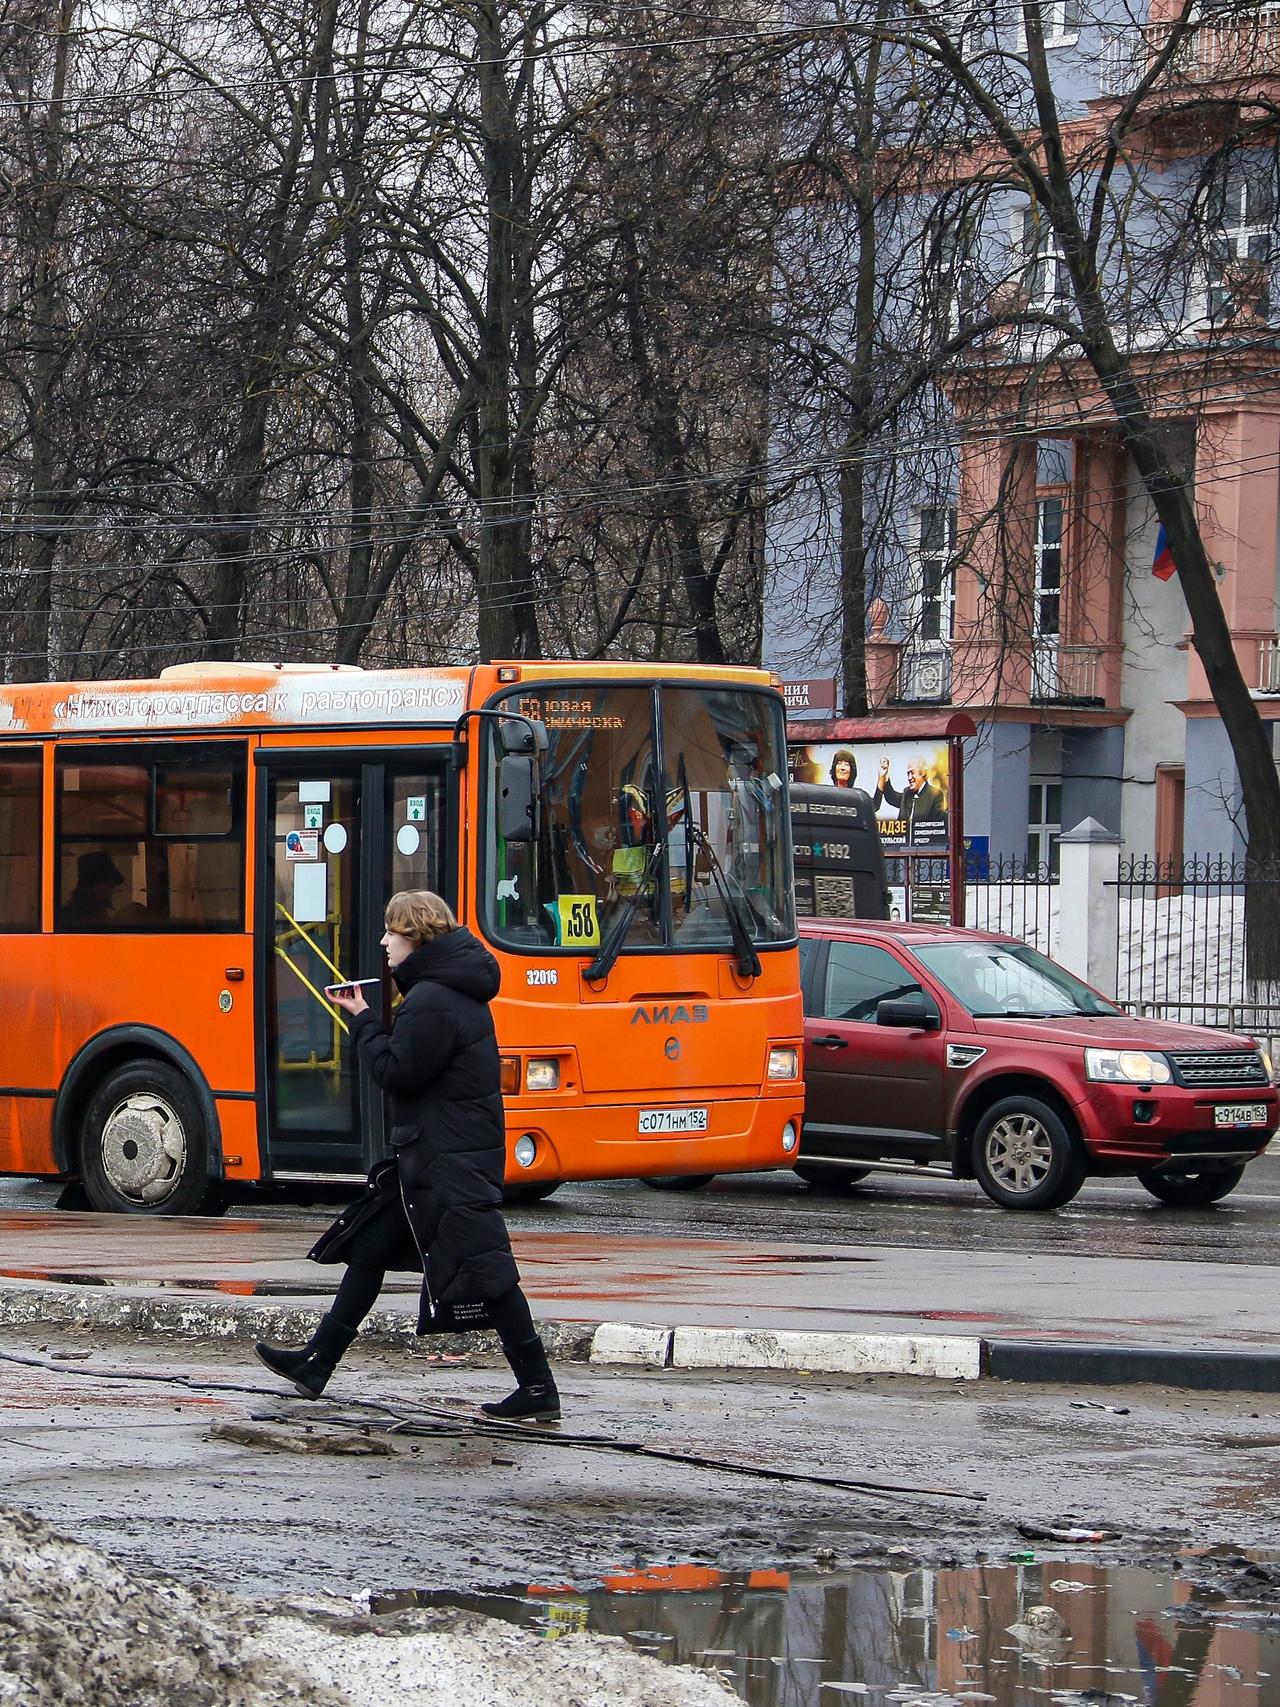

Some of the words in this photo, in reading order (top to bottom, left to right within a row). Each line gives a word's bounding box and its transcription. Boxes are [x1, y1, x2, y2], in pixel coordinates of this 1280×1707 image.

[783, 685, 809, 695] НИЯ
[823, 843, 851, 859] 1992
[526, 969, 557, 985] 32016
[630, 1005, 709, 1025] ЛИАЗ
[688, 1110, 704, 1124] 152
